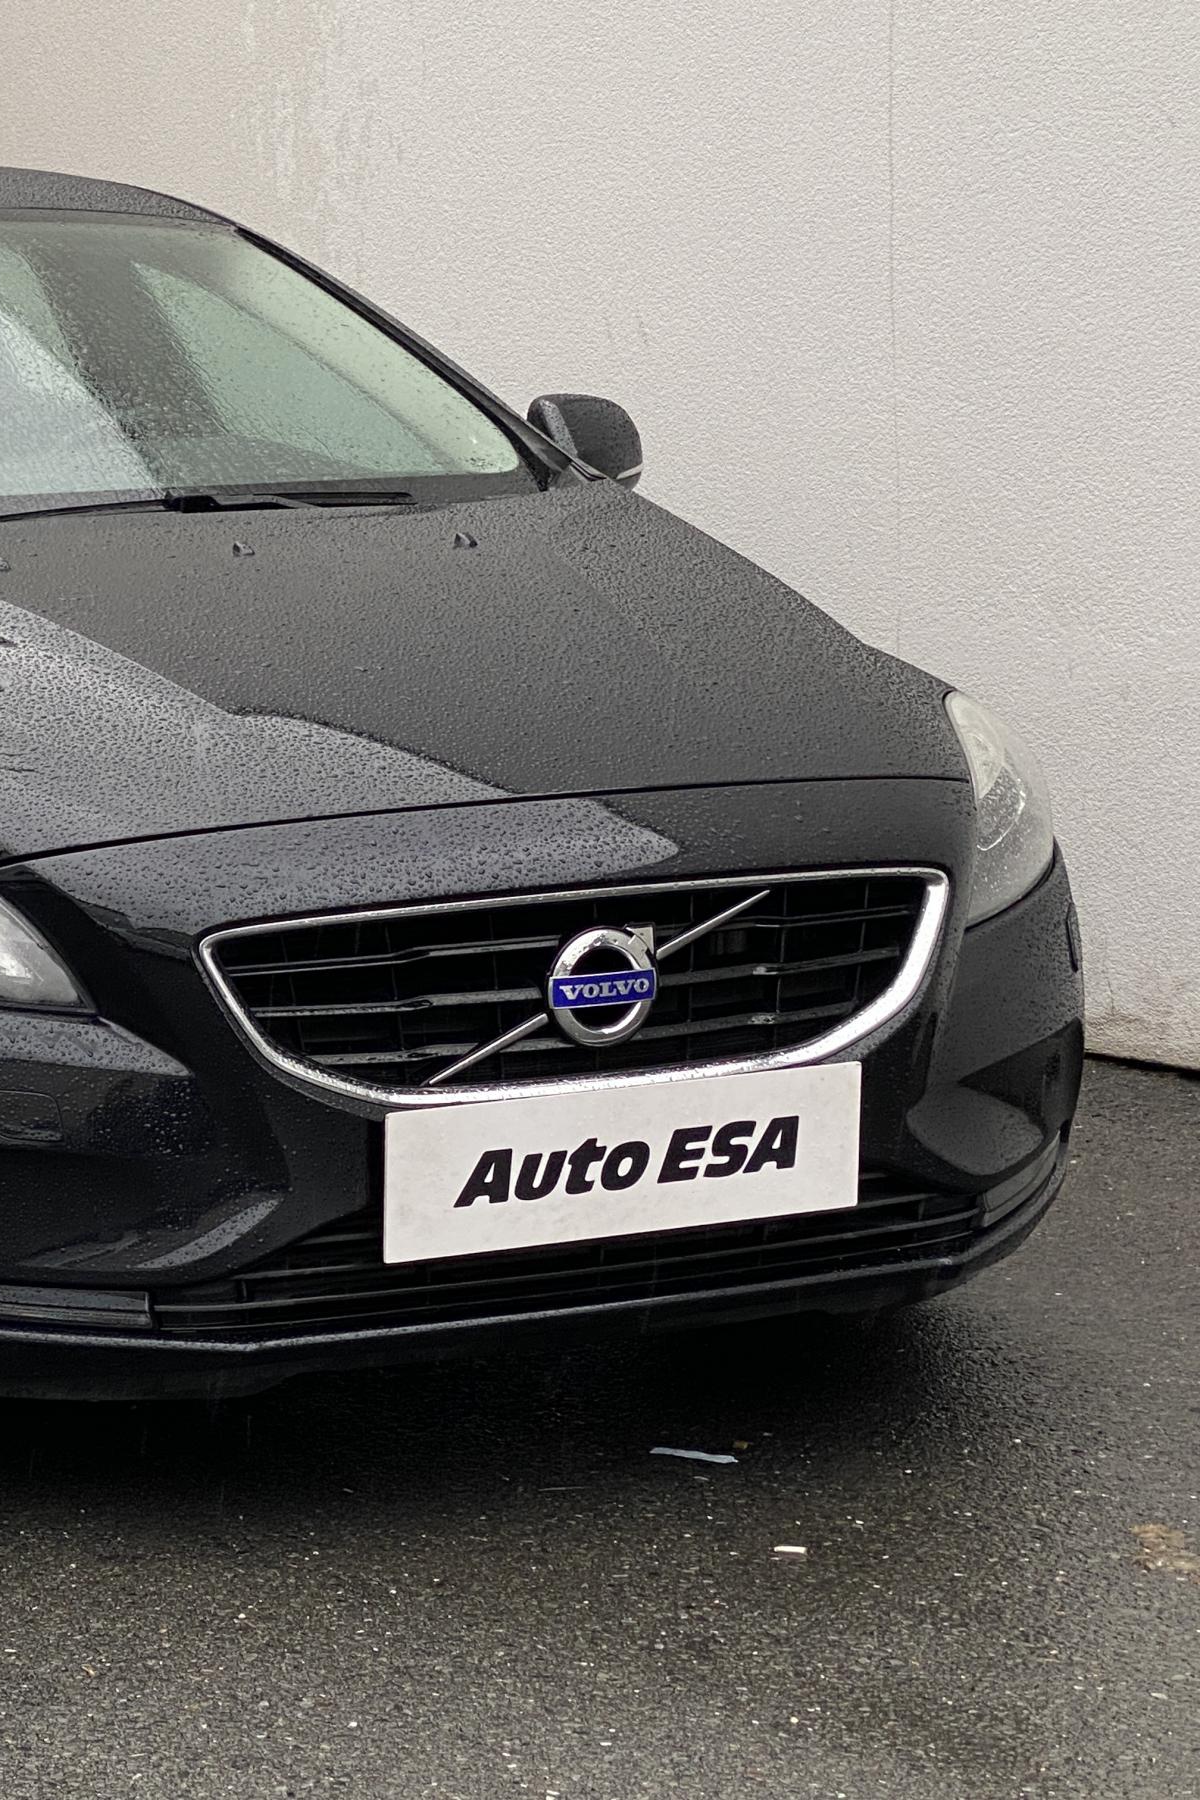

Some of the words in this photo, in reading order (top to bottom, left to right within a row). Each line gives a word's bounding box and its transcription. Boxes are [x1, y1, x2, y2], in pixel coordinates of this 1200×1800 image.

[559, 978, 650, 1000] VOLVO
[453, 1137, 650, 1208] Auto
[656, 1115, 800, 1184] ESA
